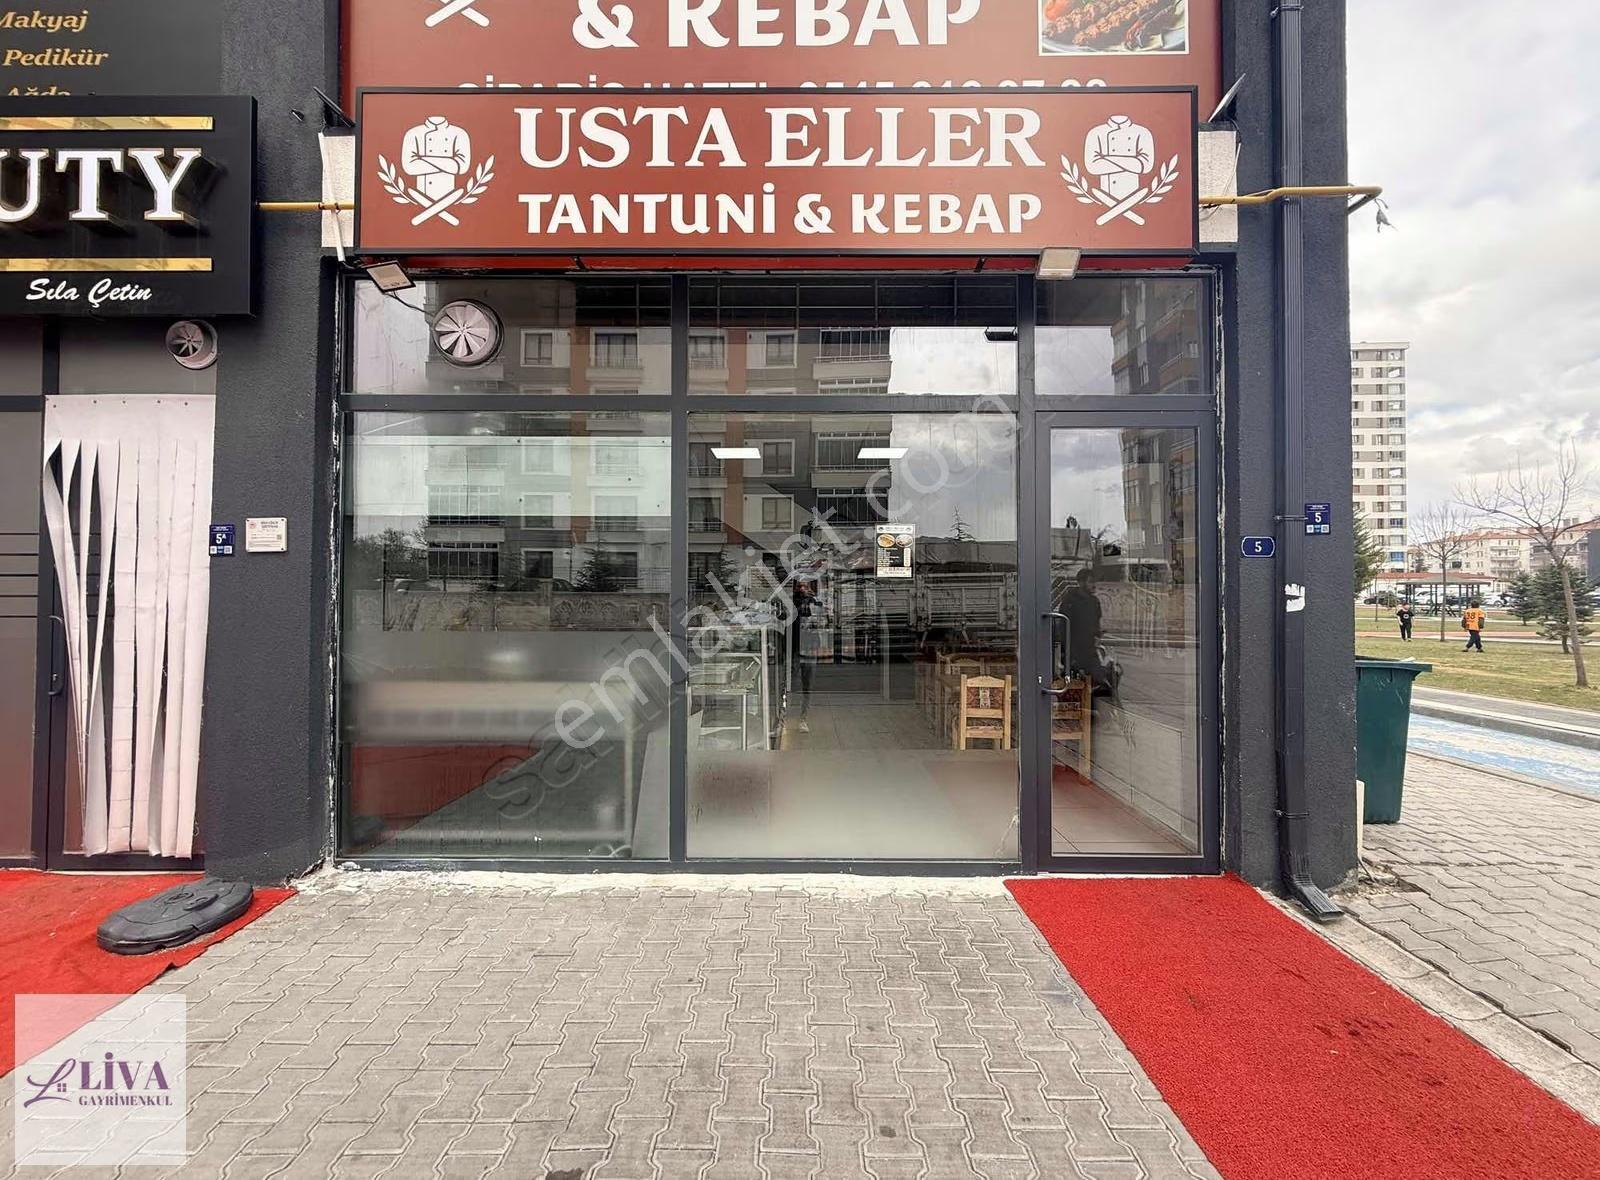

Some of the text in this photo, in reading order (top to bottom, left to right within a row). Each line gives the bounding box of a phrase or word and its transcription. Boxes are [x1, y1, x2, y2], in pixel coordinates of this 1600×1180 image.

[2, 48, 109, 66] Pedikür
[513, 106, 1046, 169] USTA ELLER
[793, 193, 836, 234] &
[851, 192, 1042, 234] KEBAP
[88, 278, 153, 308] Çetin
[1315, 512, 1322, 523] 5
[1254, 541, 1262, 552] 5
